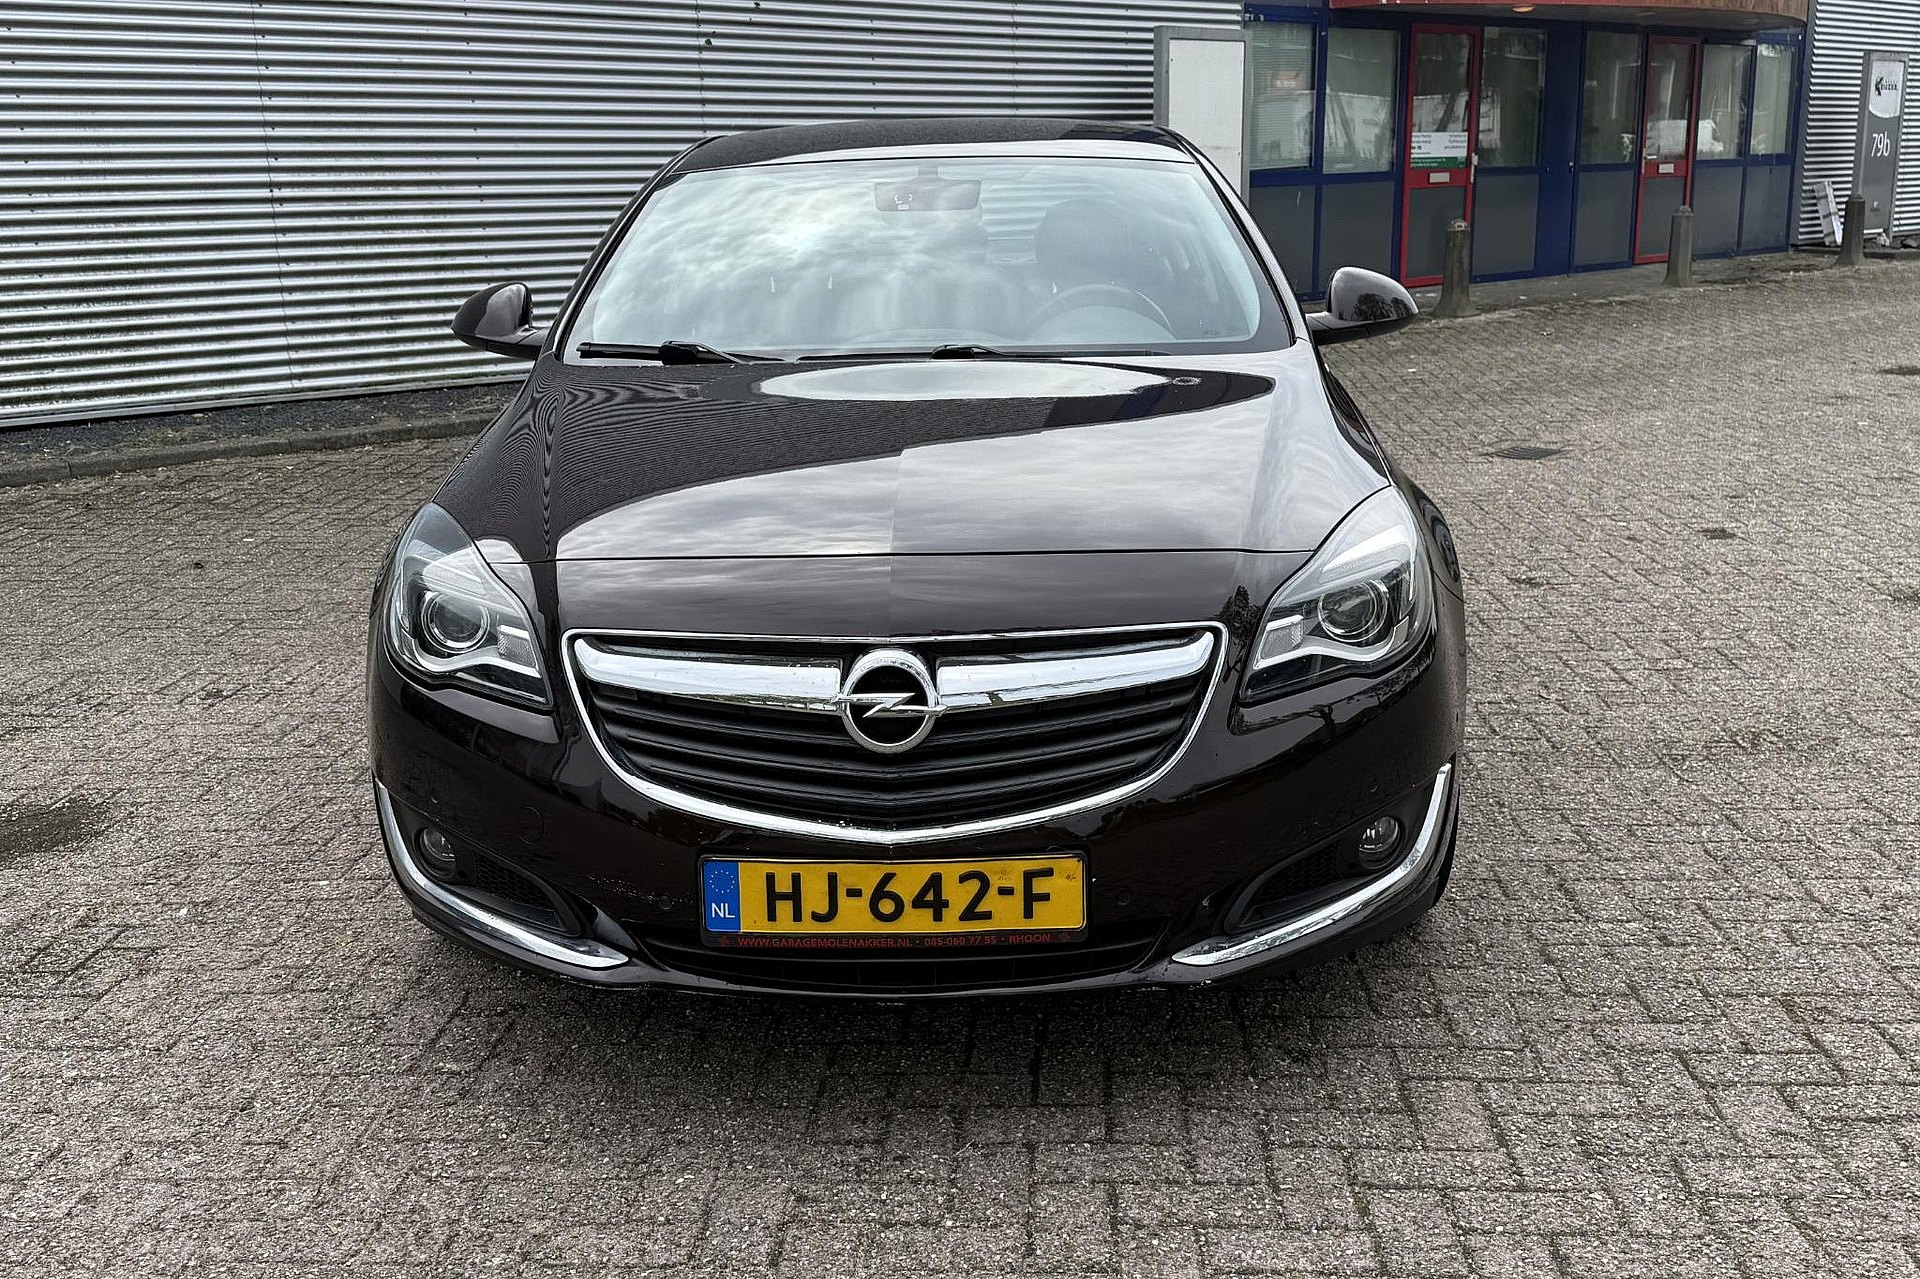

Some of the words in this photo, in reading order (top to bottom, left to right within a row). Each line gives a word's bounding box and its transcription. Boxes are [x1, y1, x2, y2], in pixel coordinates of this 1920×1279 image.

[1871, 131, 1891, 157] 79b
[765, 867, 1054, 923] HJ-642-F
[711, 902, 736, 918] NL
[737, 937, 912, 949] WWW.GARAGEMOLENAKKER.NL
[1009, 933, 1051, 945] RHOON
